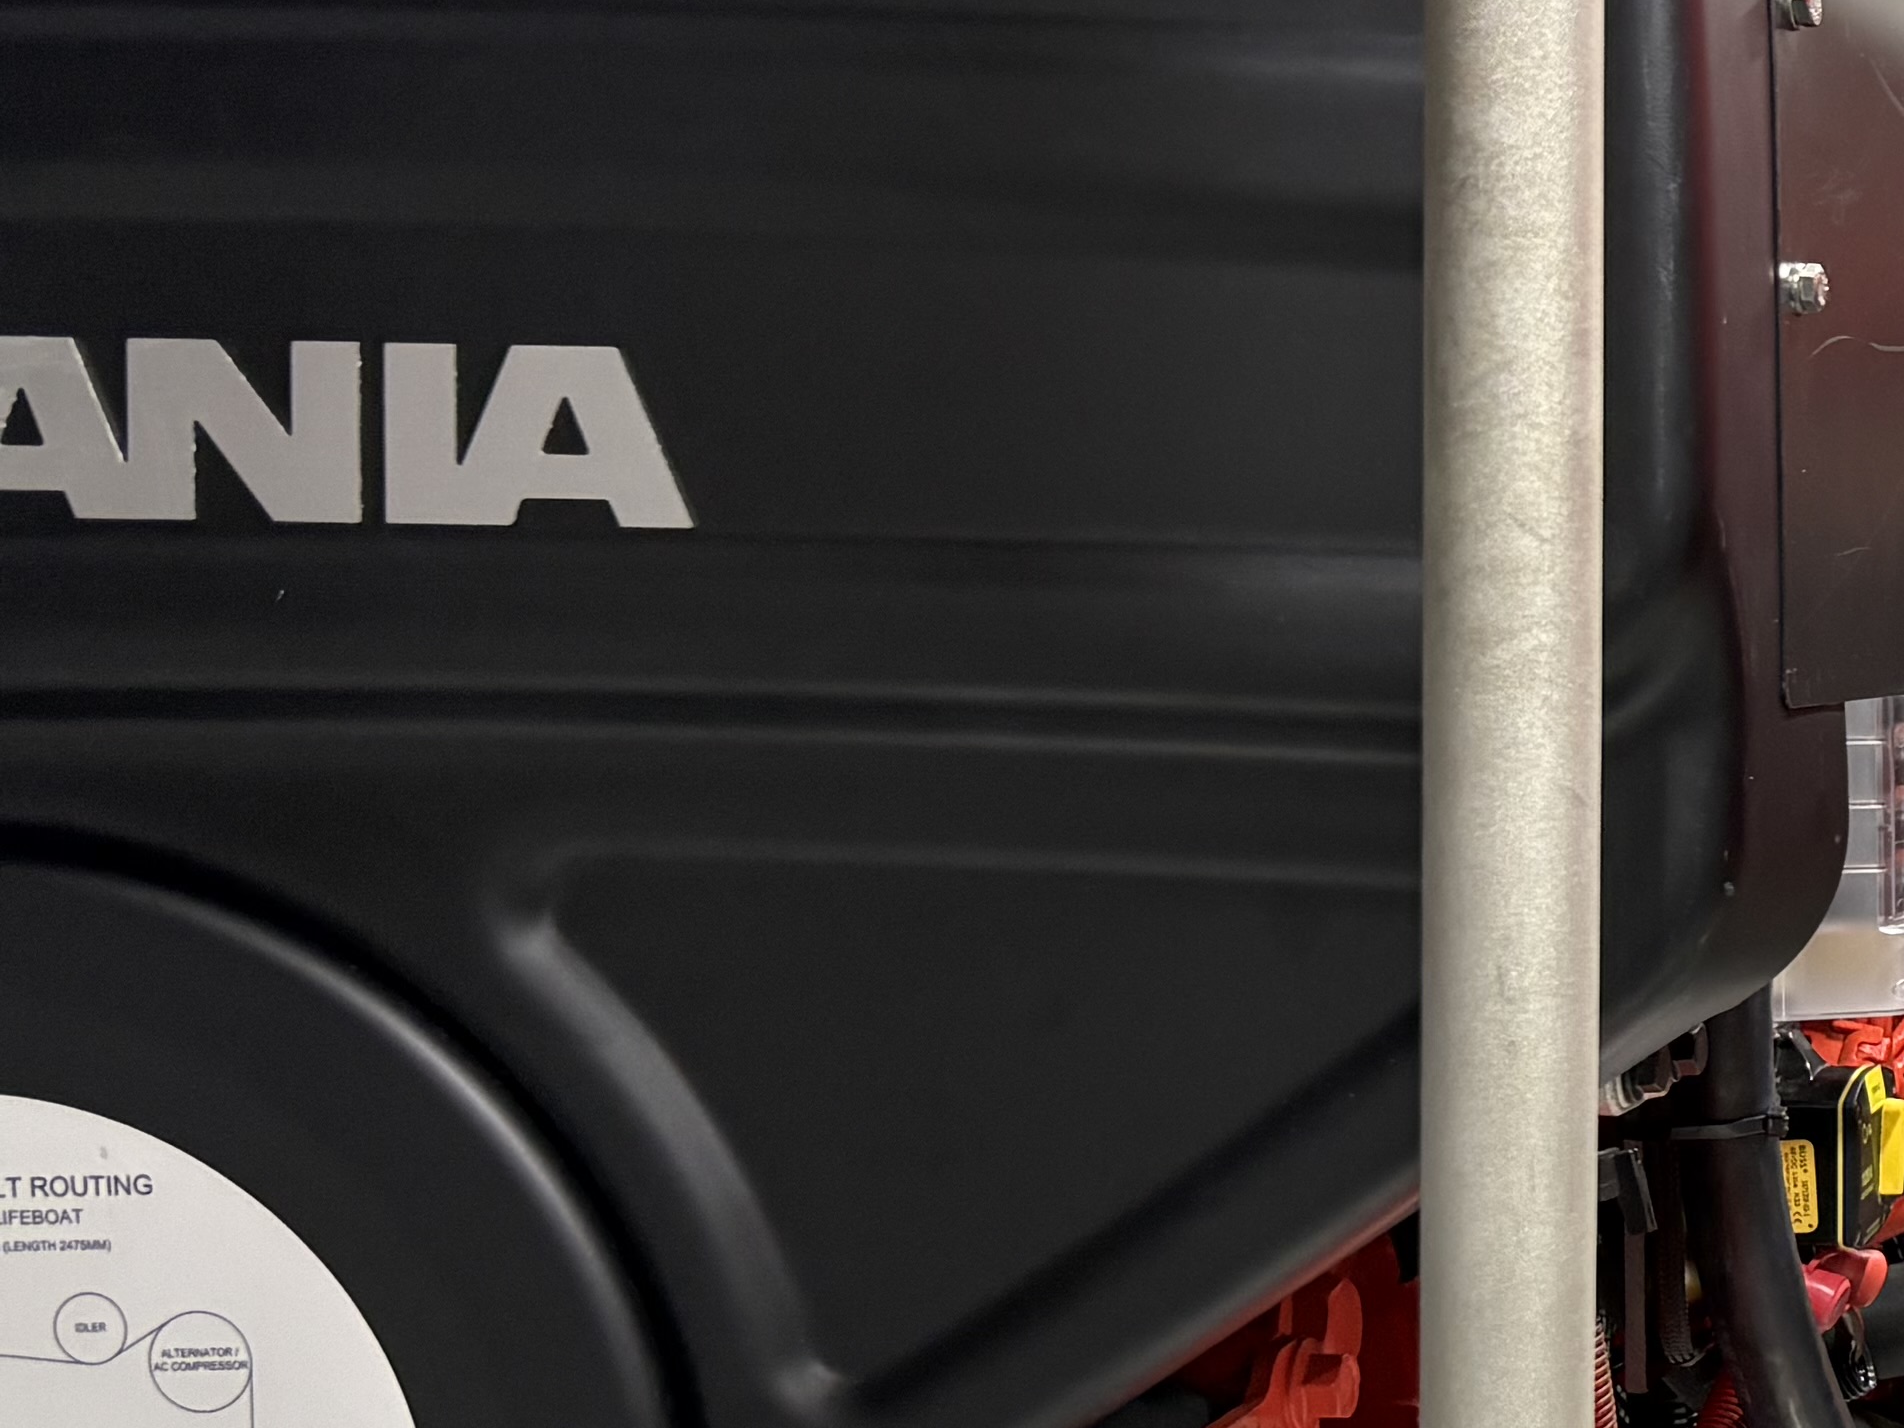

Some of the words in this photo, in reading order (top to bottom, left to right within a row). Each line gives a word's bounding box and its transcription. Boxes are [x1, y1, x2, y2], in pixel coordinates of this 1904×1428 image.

[30, 1174, 154, 1197] ROUTING
[0, 1208, 83, 1225] IFEBOAT
[3, 1240, 57, 1254] (LENGTH
[59, 1239, 111, 1252] 2475MM)
[74, 1322, 107, 1333] IDLER
[161, 1347, 232, 1359] ALTERNATOR
[153, 1362, 169, 1372] AC
[171, 1360, 248, 1372] COMPRESSOR
